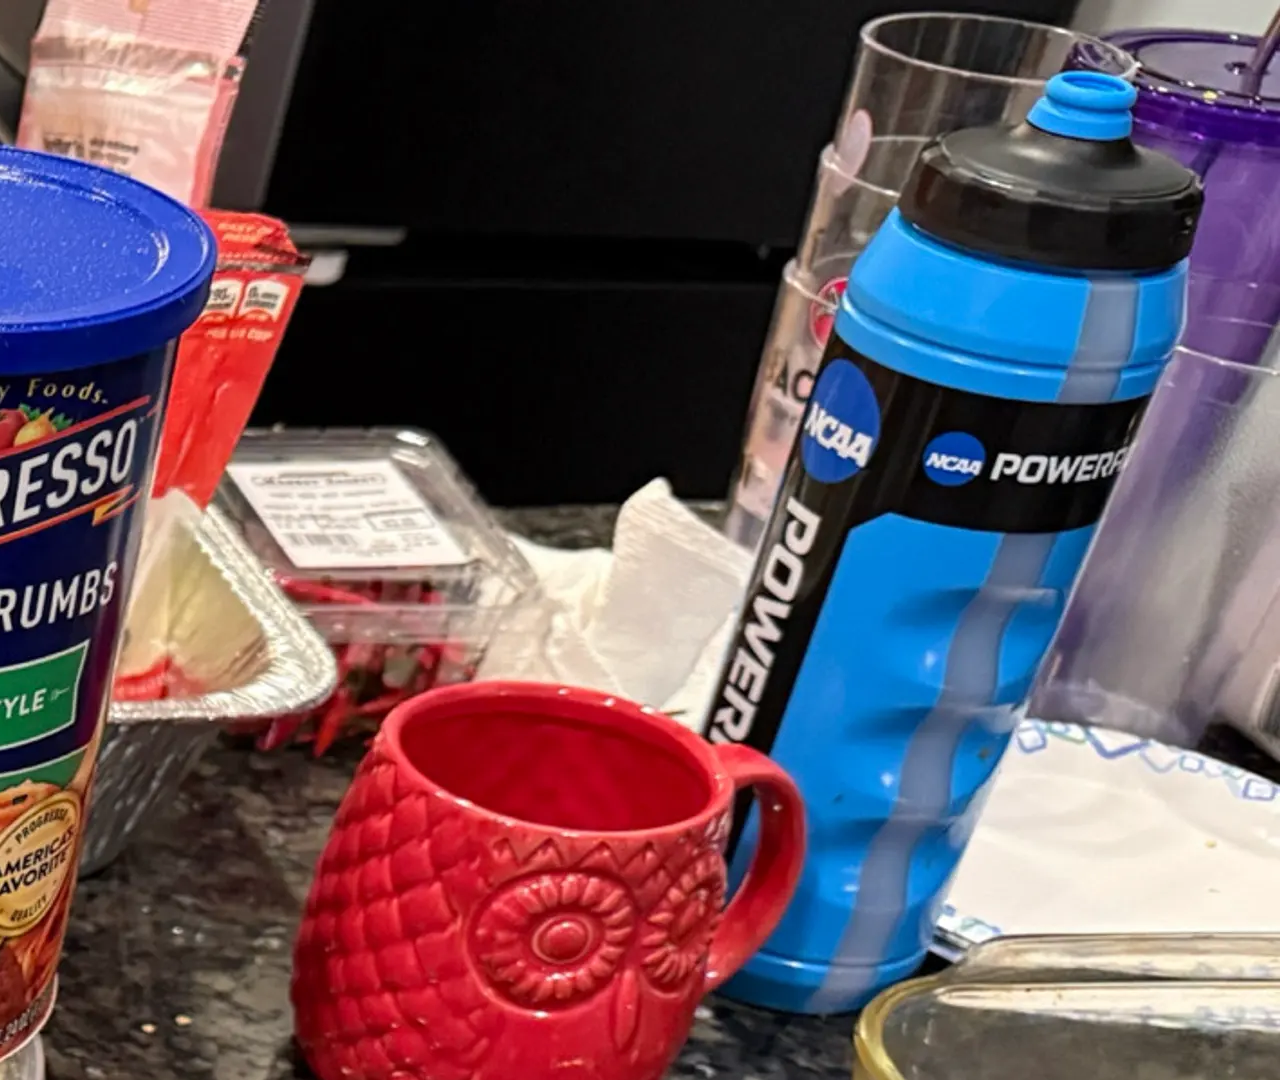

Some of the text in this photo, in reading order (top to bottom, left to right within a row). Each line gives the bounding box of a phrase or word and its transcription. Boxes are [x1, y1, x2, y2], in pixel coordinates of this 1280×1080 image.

[804, 401, 874, 469] NCAA
[925, 451, 982, 477] NCAA
[989, 446, 1128, 485] POWERA
[709, 496, 823, 745] POWER
[9, 894, 47, 922] QUALITY
